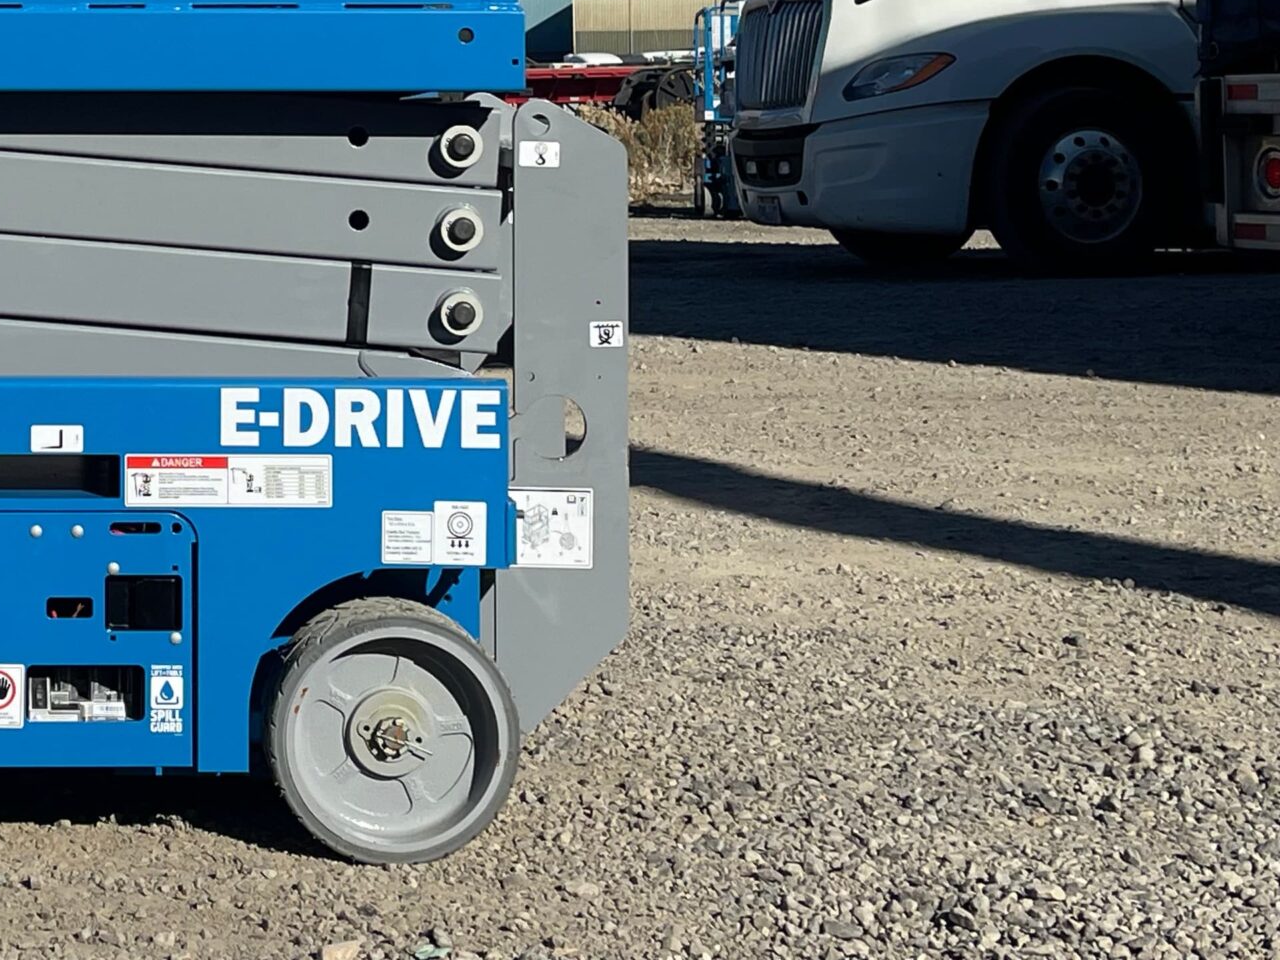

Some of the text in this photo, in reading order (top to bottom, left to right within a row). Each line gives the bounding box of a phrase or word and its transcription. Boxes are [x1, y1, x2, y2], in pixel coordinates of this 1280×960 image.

[219, 387, 502, 450] E-DRIVE
[160, 457, 204, 467] DANGER
[150, 709, 183, 722] SPILL
[150, 722, 183, 733] GUARD
